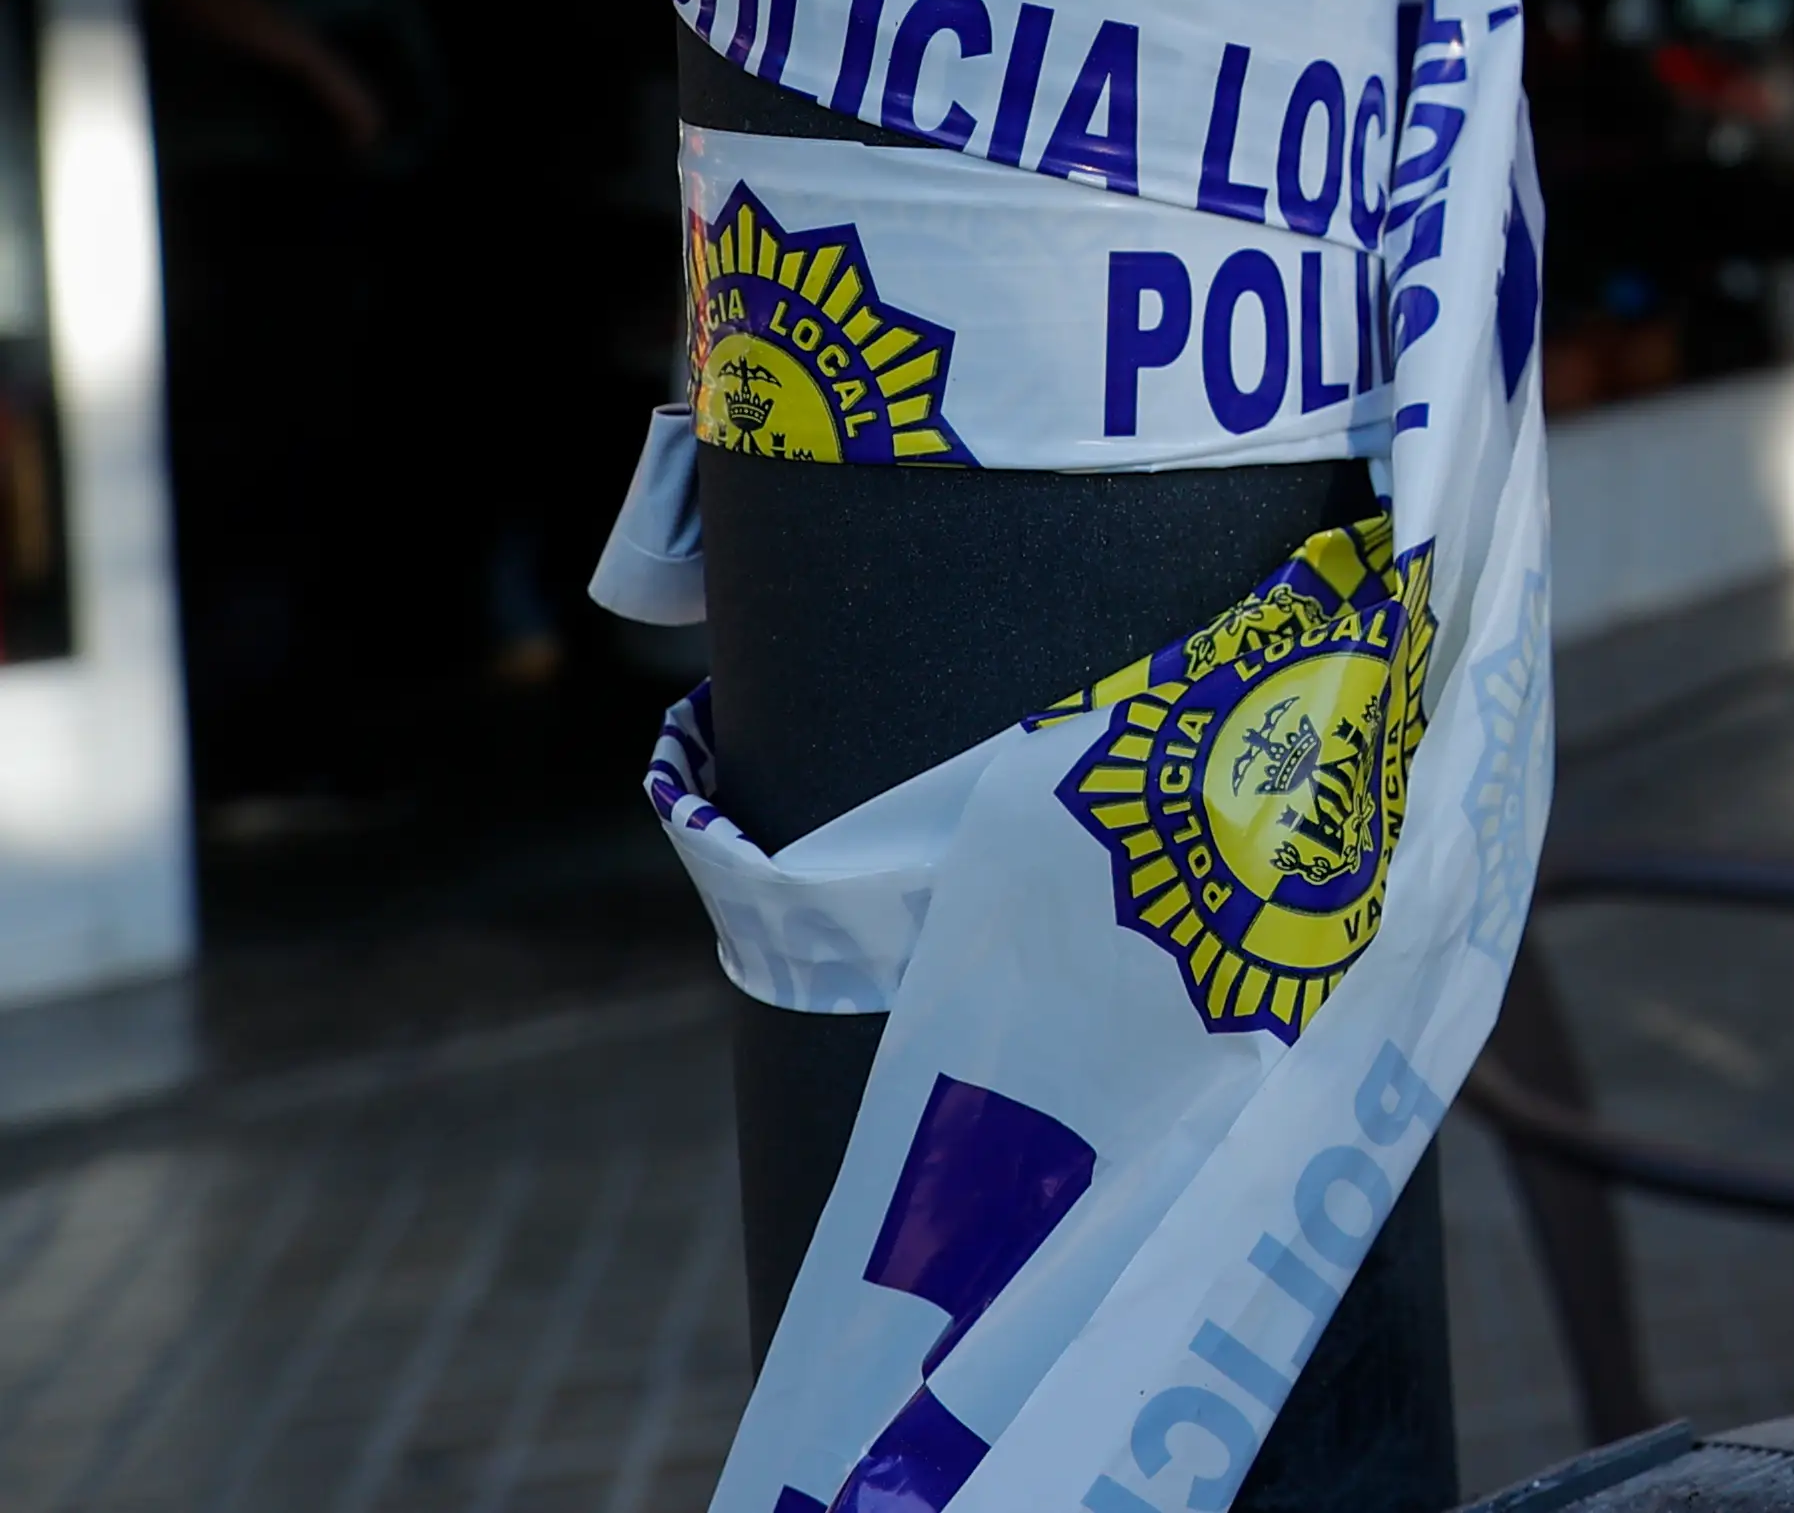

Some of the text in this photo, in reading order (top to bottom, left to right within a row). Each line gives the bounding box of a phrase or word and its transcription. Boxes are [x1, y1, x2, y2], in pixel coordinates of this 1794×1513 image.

[769, 301, 887, 438] LOCAL
[1159, 610, 1391, 913] POLICIA LOCAL
